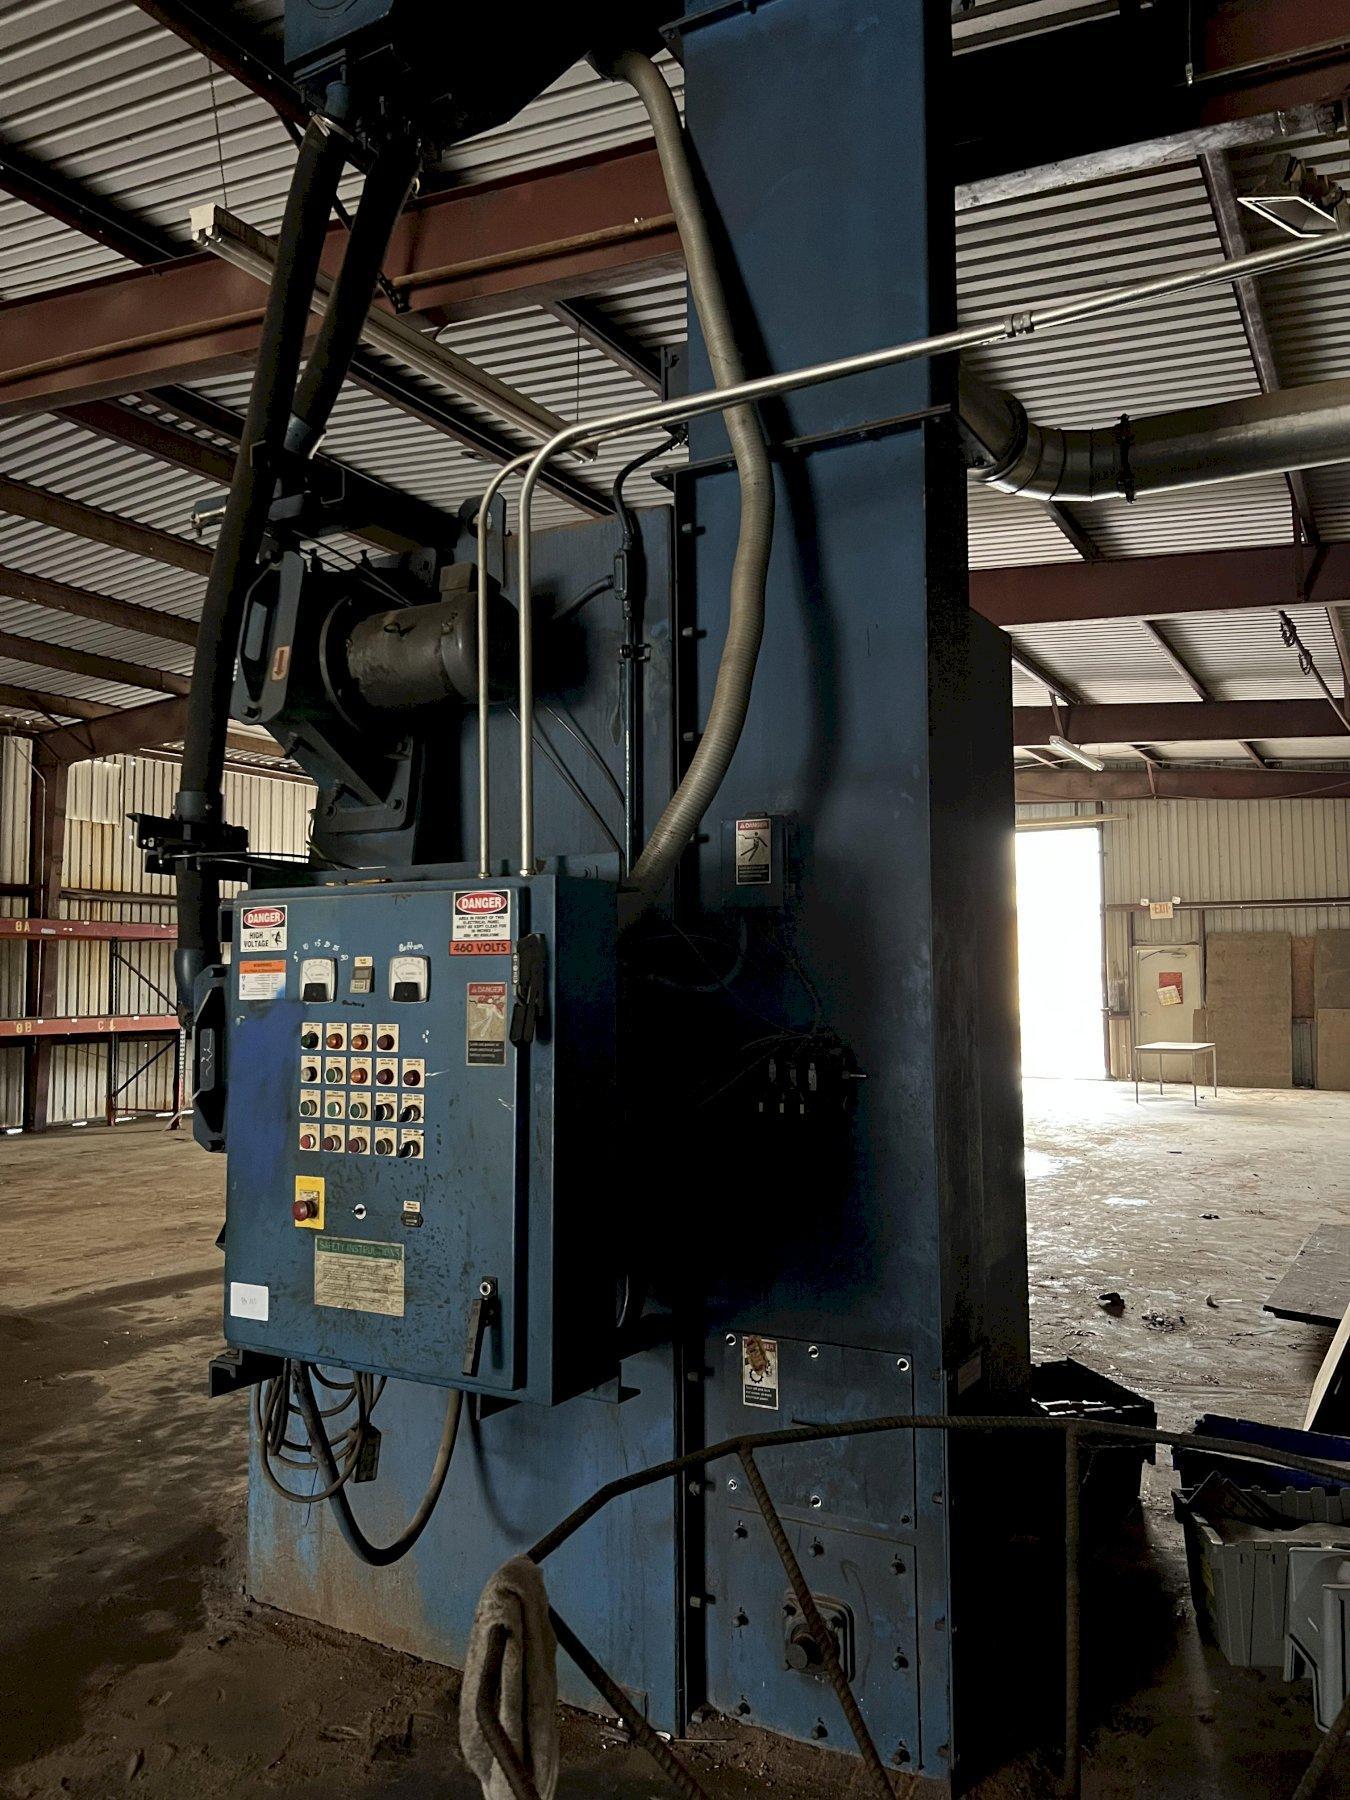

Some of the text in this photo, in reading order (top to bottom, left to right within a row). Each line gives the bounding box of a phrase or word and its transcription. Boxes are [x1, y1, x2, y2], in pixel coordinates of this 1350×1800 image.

[461, 897, 502, 909] DANGER
[1154, 903, 1169, 914] EXIT
[248, 912, 280, 923] DANGER
[244, 940, 269, 948] VOLTAGE
[453, 942, 507, 952] 460 VOLTS
[320, 1240, 344, 1251] SAFETY
